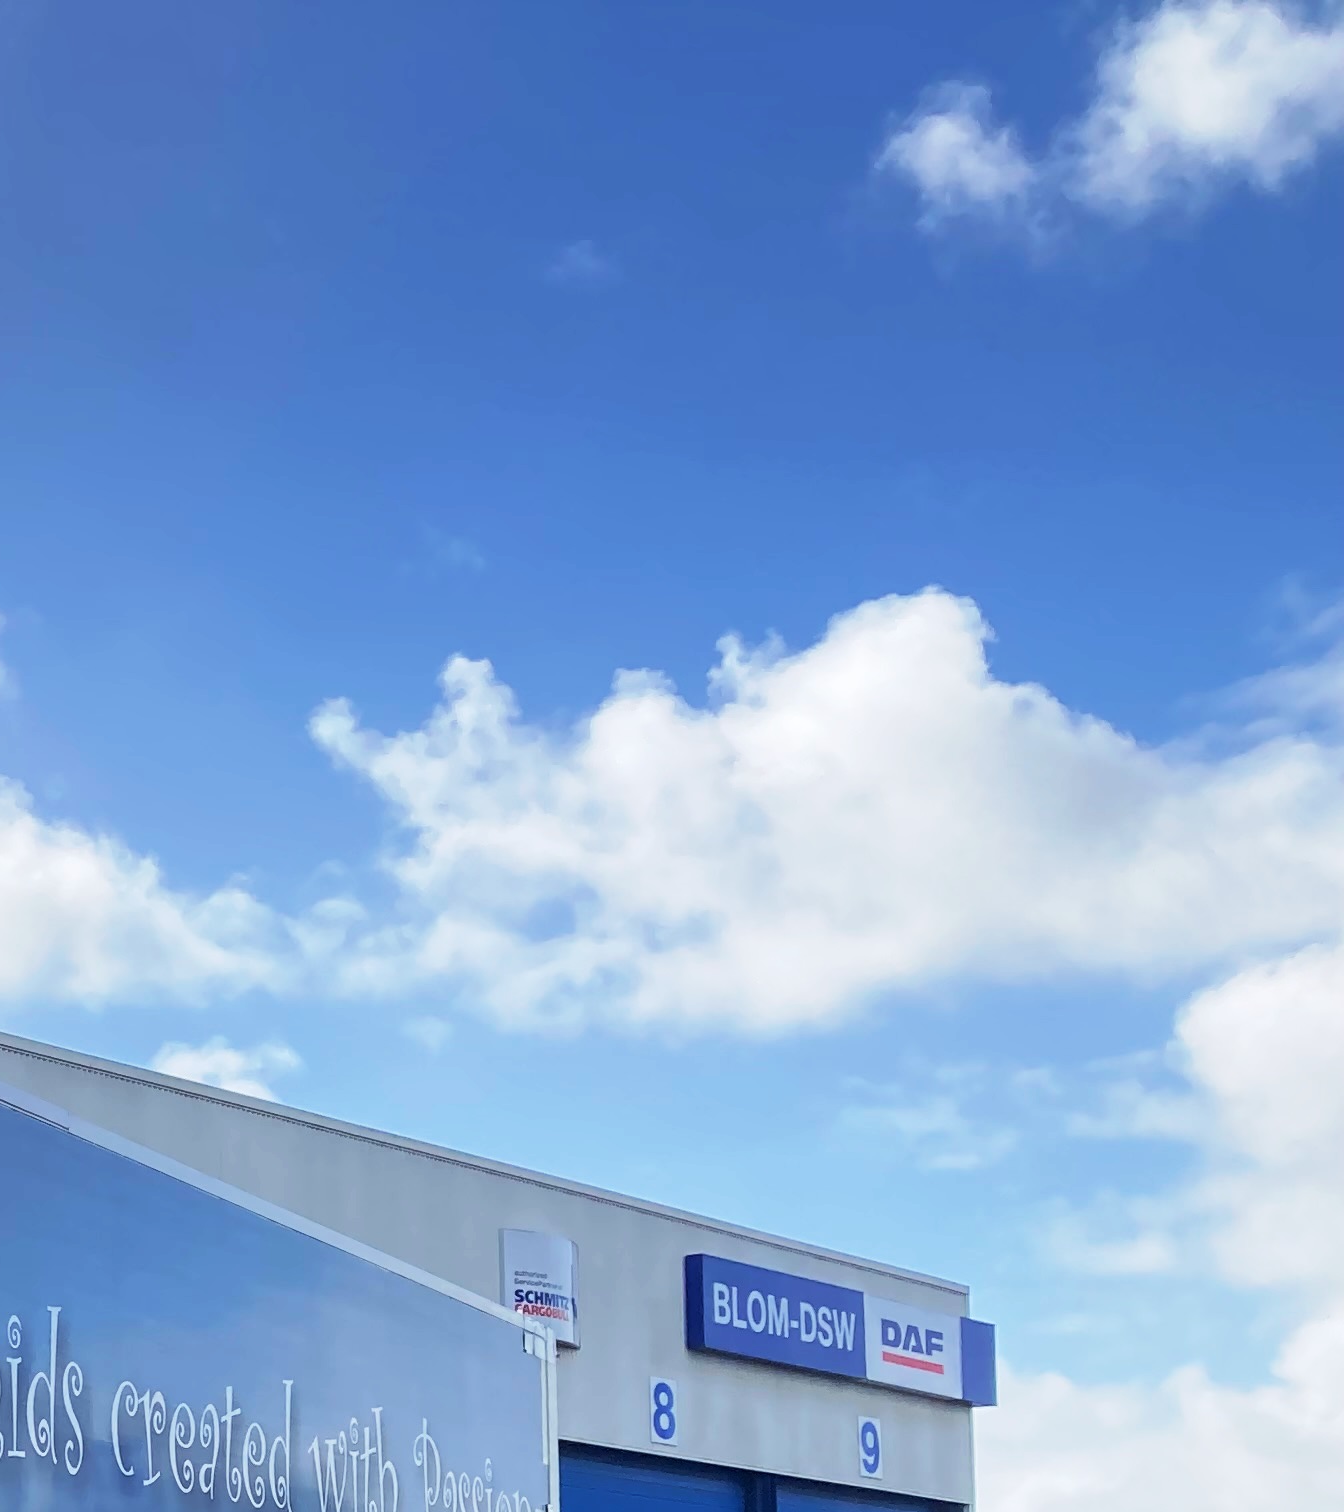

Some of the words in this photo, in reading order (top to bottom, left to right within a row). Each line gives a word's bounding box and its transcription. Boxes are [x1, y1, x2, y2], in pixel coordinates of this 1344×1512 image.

[514, 1289, 569, 1310] SCHMITZ
[712, 1282, 857, 1351] BLOM-DSW
[880, 1317, 944, 1356] DAF
[653, 1381, 676, 1440] 8
[861, 1420, 880, 1474] 9
